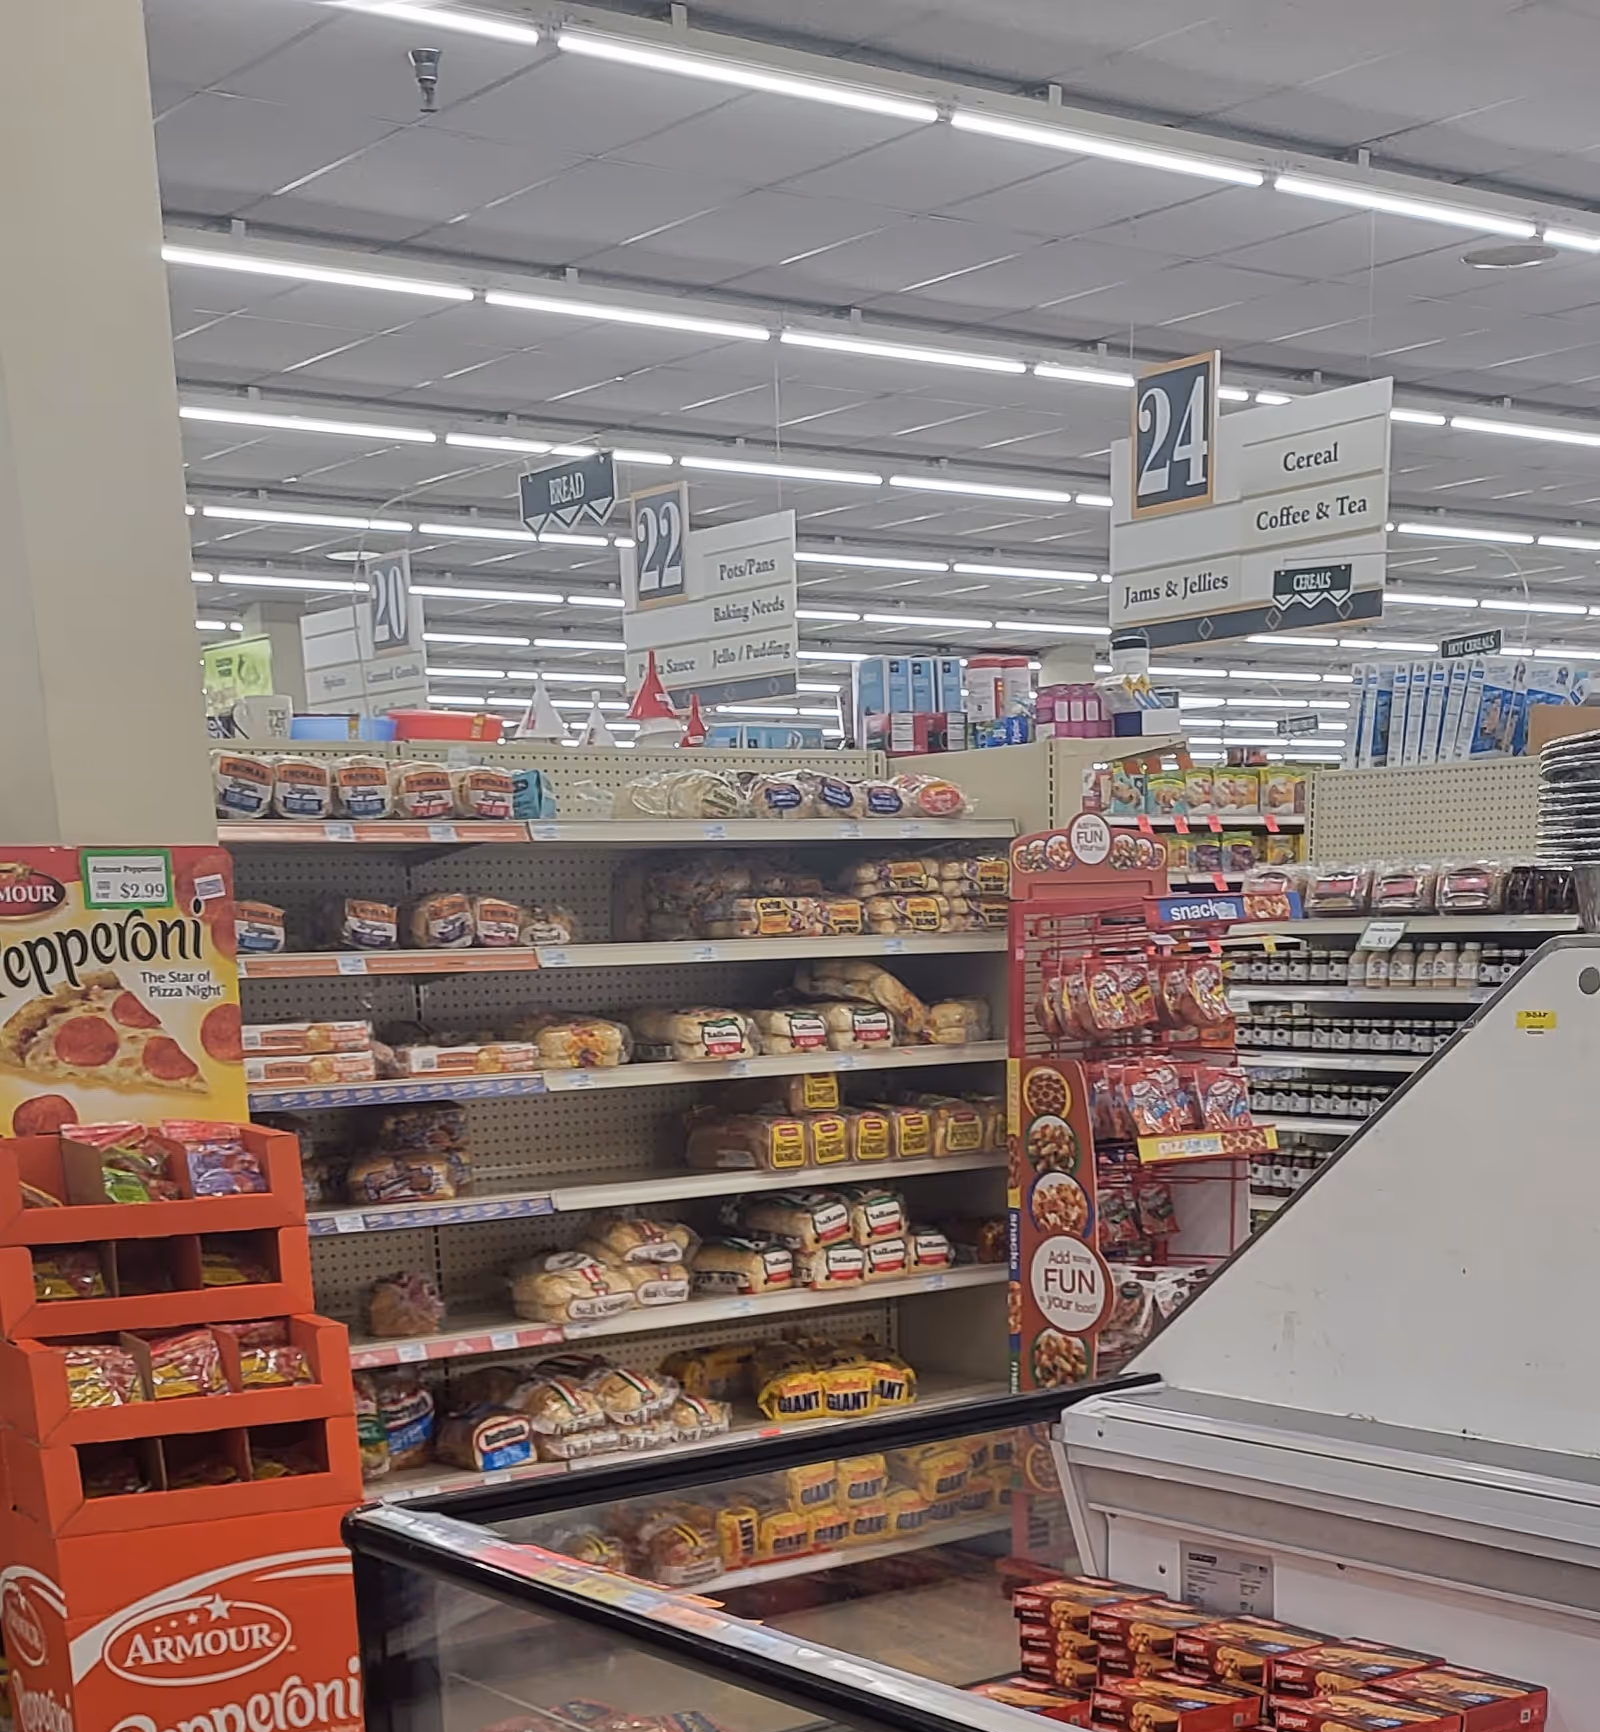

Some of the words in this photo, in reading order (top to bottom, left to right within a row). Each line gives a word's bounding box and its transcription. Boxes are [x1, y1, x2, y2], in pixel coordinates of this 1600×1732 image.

[1138, 376, 1208, 496] 24
[1283, 442, 1339, 472] Cereal
[549, 472, 585, 505] BREAD
[1256, 505, 1311, 531] Coffee
[1315, 501, 1330, 520] &
[1335, 495, 1368, 516] Tea
[637, 501, 682, 592] 22
[719, 559, 776, 581] Pots/Pans
[1293, 571, 1332, 590] CEREALS
[372, 567, 406, 641] 20
[1124, 586, 1161, 609] Jams
[1165, 580, 1178, 597] &
[1182, 572, 1229, 599] Jellies
[713, 603, 750, 623] Baking
[751, 595, 785, 615] Needs
[667, 659, 695, 676] Sauce
[712, 647, 736, 668] Jello
[746, 640, 790, 661] Pudding
[1076, 830, 1103, 845] FUN
[120, 882, 165, 899] $2.99
[1170, 900, 1218, 921] snack
[0, 898, 202, 996] epperoni
[140, 971, 165, 984] The
[169, 971, 194, 983] Star
[198, 970, 211, 983] of
[149, 985, 183, 998] Pizza
[1009, 1212, 1019, 1271] snacks
[1048, 1250, 1070, 1265] Add
[1044, 1267, 1095, 1295] FUN
[1047, 1294, 1073, 1310] your
[778, 1390, 820, 1414] GIANT
[827, 1391, 870, 1412] GIANT
[801, 1478, 839, 1506] GIANT
[122, 1622, 274, 1668] ARMOUR
